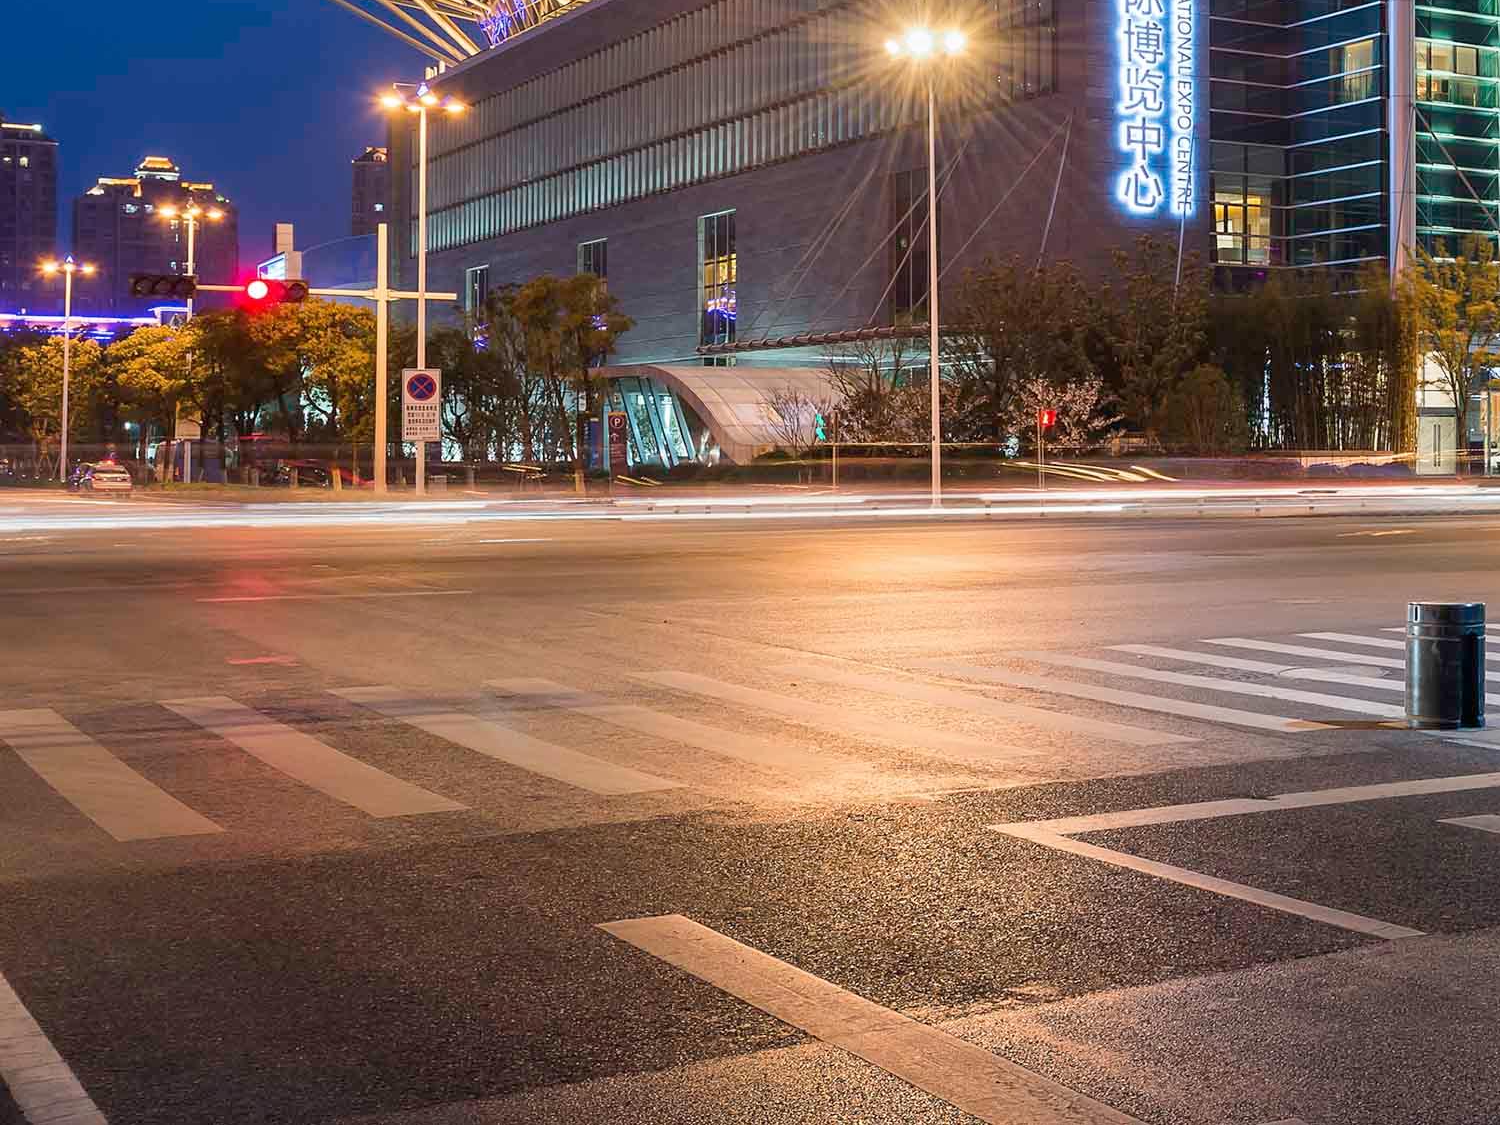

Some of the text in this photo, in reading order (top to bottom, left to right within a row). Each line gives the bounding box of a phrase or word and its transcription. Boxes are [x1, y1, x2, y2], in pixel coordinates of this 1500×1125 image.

[1177, 80, 1192, 131] EXPO
[1177, 136, 1192, 212] CENTRE
[614, 418, 621, 427] P
